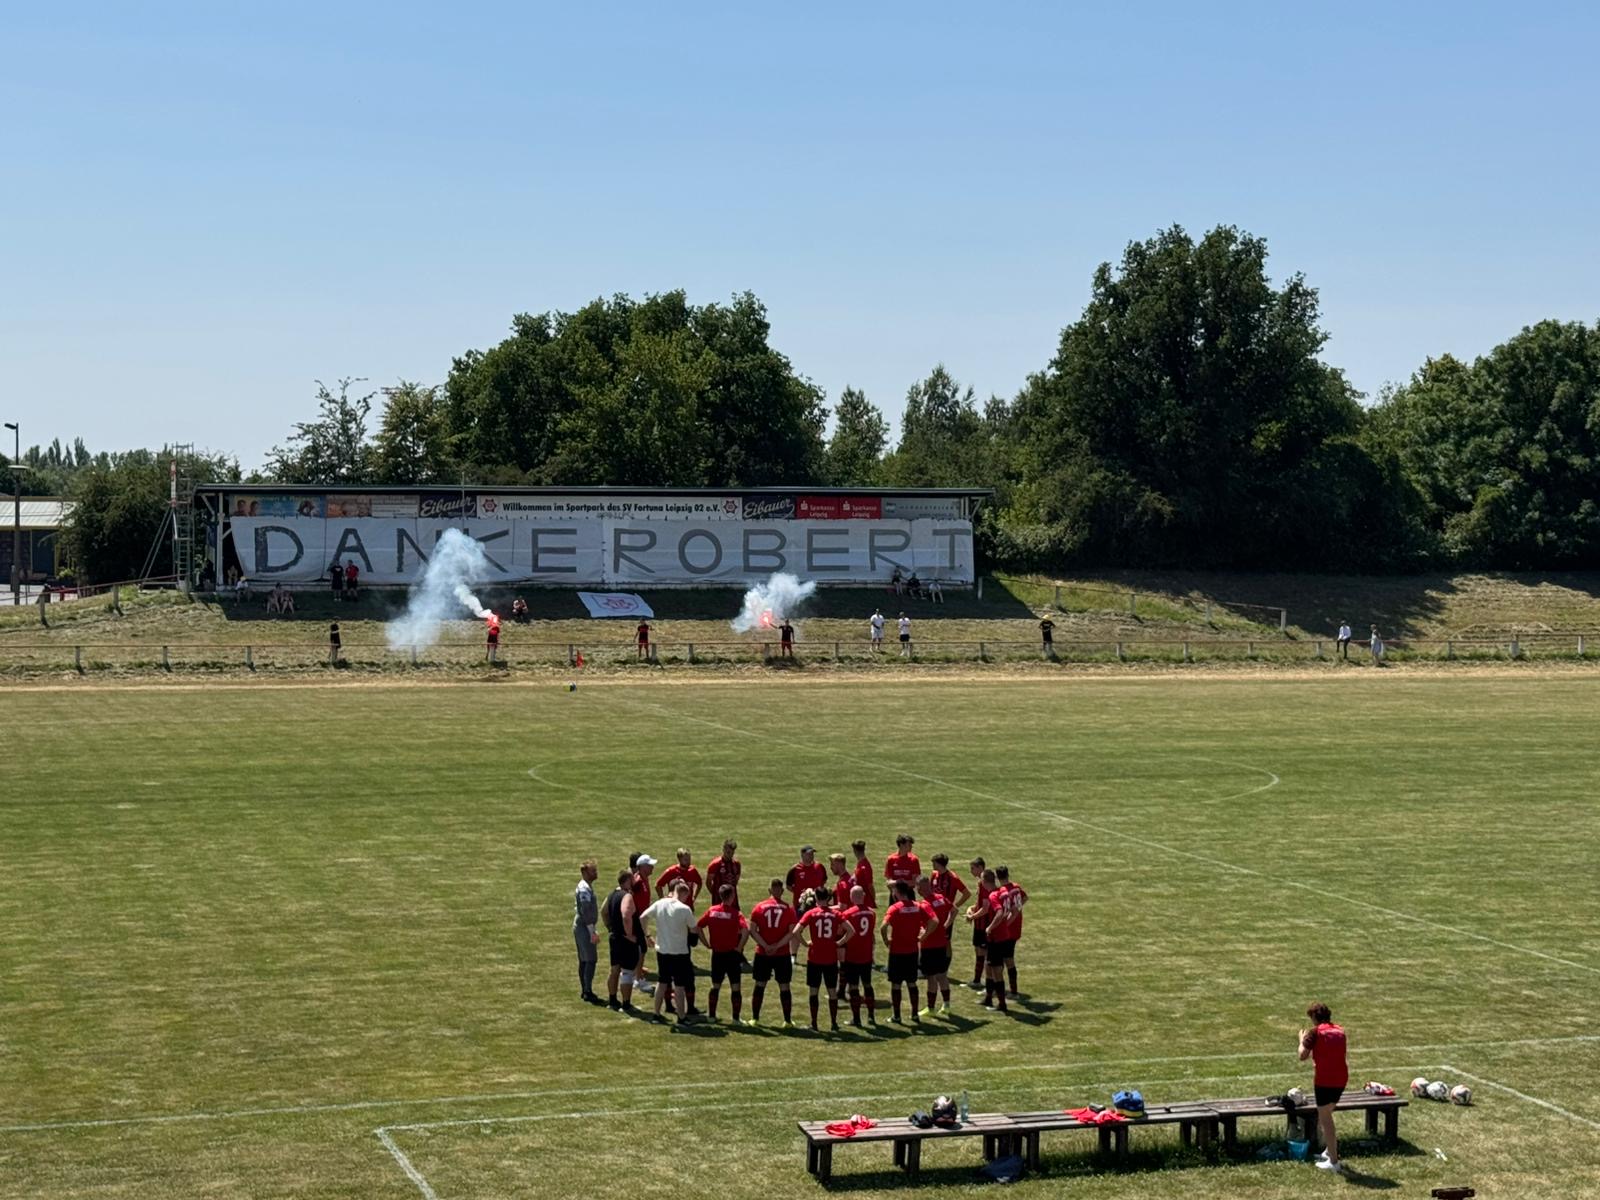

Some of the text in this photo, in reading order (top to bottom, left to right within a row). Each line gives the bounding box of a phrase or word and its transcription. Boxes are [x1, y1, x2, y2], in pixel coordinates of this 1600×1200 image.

[502, 503, 720, 513] Willkommen im Sportpark des SV Fortuna Leipzig 02 e.V.
[743, 498, 795, 519] Eibauer
[613, 527, 972, 575] ROBERT
[764, 909, 783, 928] 17
[815, 918, 833, 938] 13
[860, 916, 869, 937] 9
